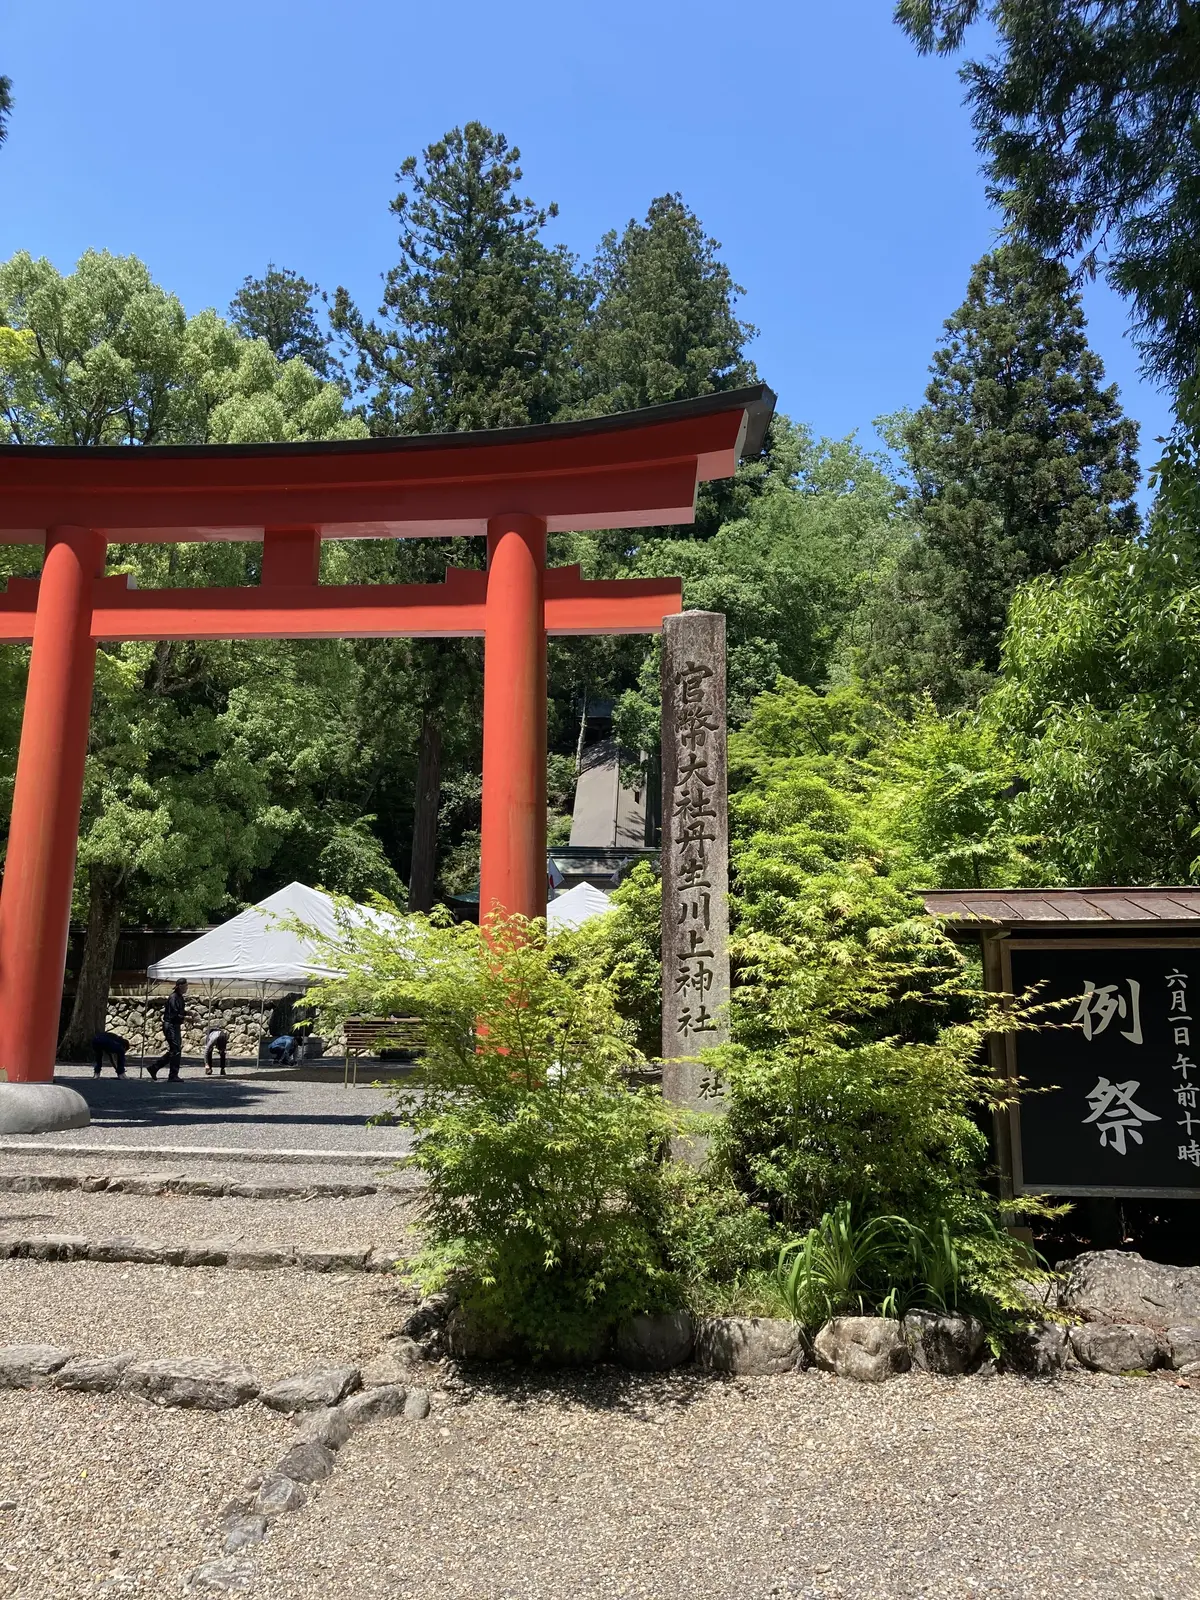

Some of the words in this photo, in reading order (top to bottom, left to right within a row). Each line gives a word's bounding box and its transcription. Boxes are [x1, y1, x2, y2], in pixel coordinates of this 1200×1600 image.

[1072, 978, 1162, 1156] 例祭
[1164, 968, 1200, 1167] 六月一日午前十時
